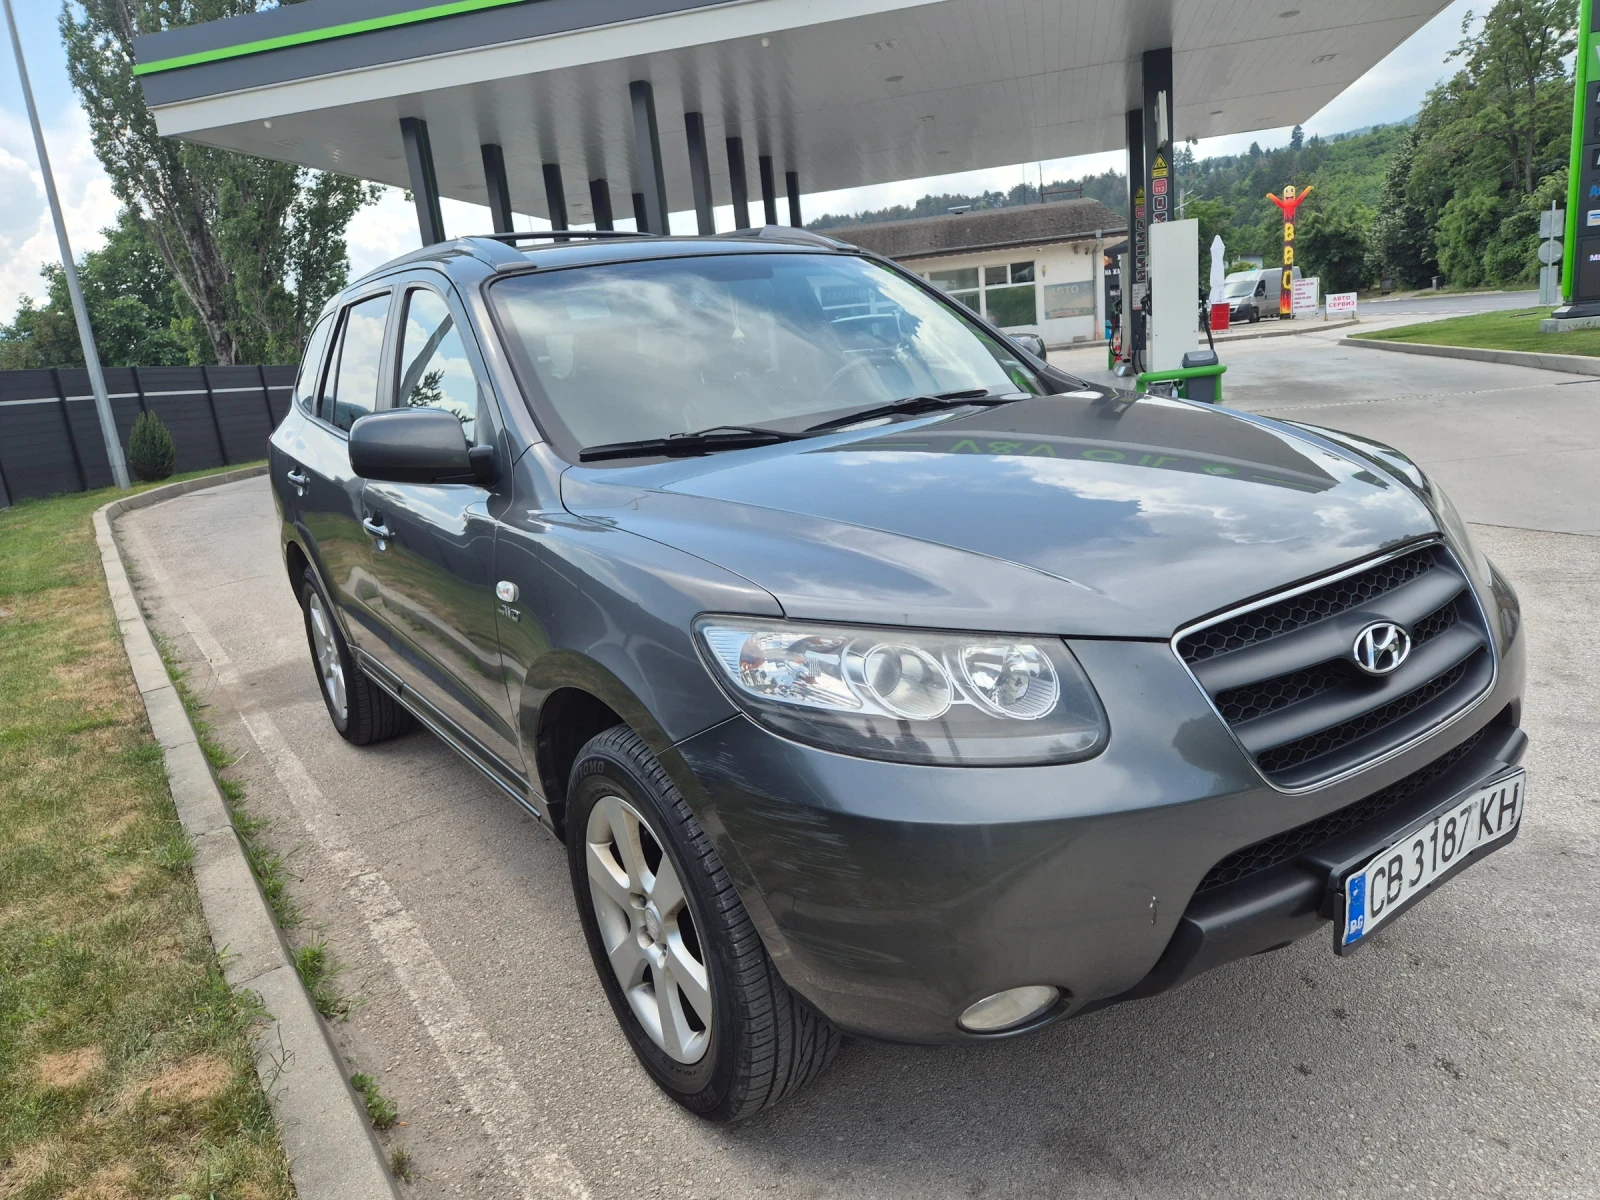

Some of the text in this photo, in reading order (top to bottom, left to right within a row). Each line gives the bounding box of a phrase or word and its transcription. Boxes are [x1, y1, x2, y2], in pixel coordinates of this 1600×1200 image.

[1282, 223, 1294, 289] BBQ
[1370, 781, 1520, 918] CB 3187 KH
[1350, 914, 1363, 934] BG
